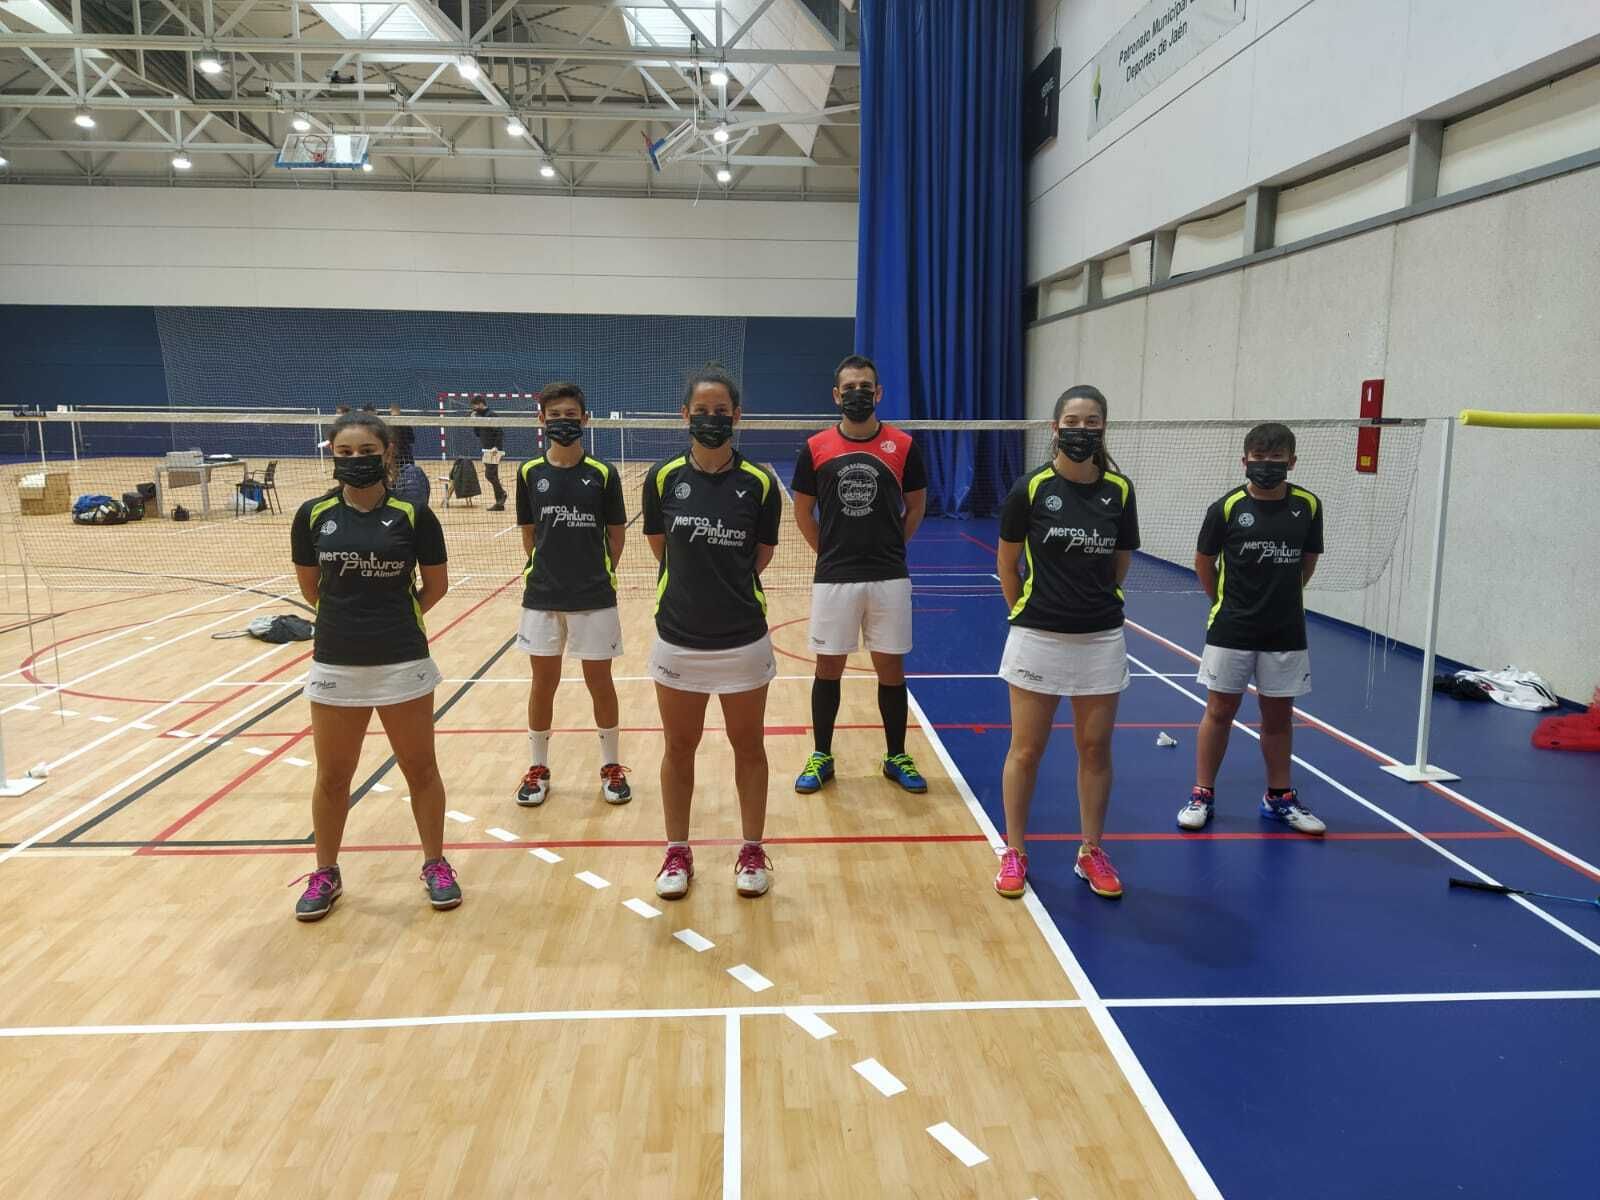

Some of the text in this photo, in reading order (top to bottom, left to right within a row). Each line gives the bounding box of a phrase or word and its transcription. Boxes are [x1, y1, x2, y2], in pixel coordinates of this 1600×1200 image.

[1119, 29, 1151, 67] Patronato
[1126, 21, 1187, 82] Deportes de Jaén
